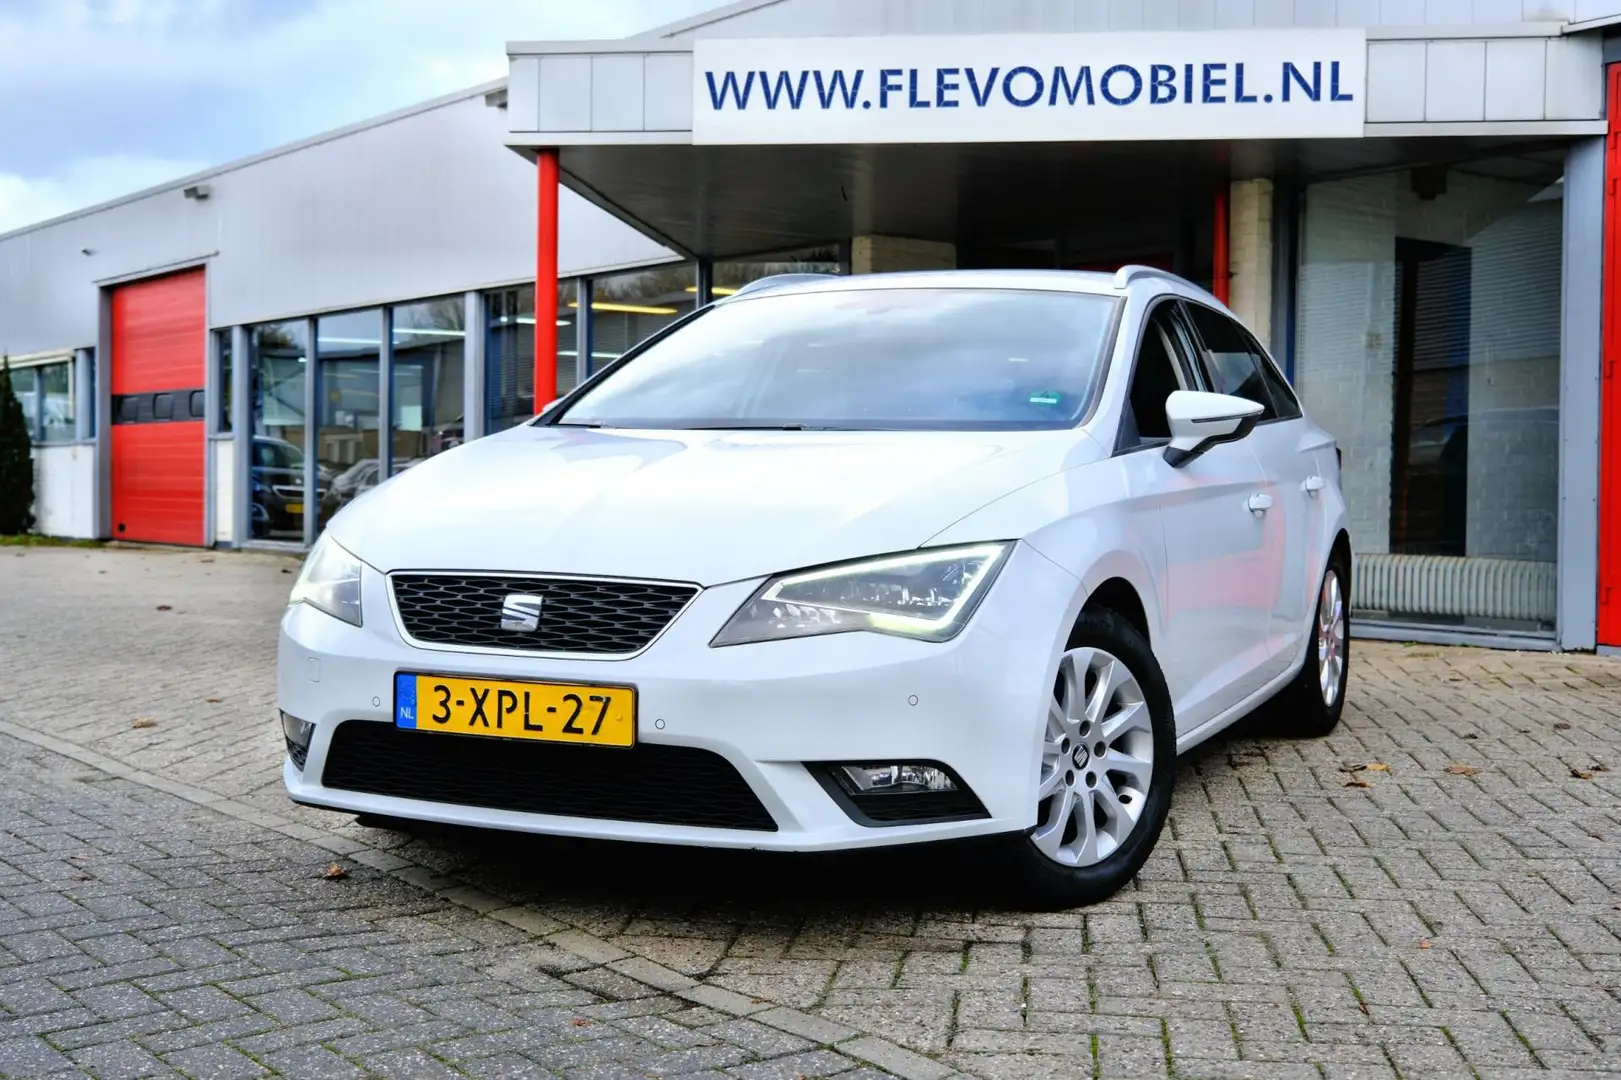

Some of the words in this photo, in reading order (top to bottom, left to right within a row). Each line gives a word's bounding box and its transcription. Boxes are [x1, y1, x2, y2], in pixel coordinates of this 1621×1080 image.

[705, 61, 1353, 110] WWW.FLEVOMOBIEL.NL
[400, 706, 414, 719] NL
[432, 684, 612, 736] 3-XPL-27
